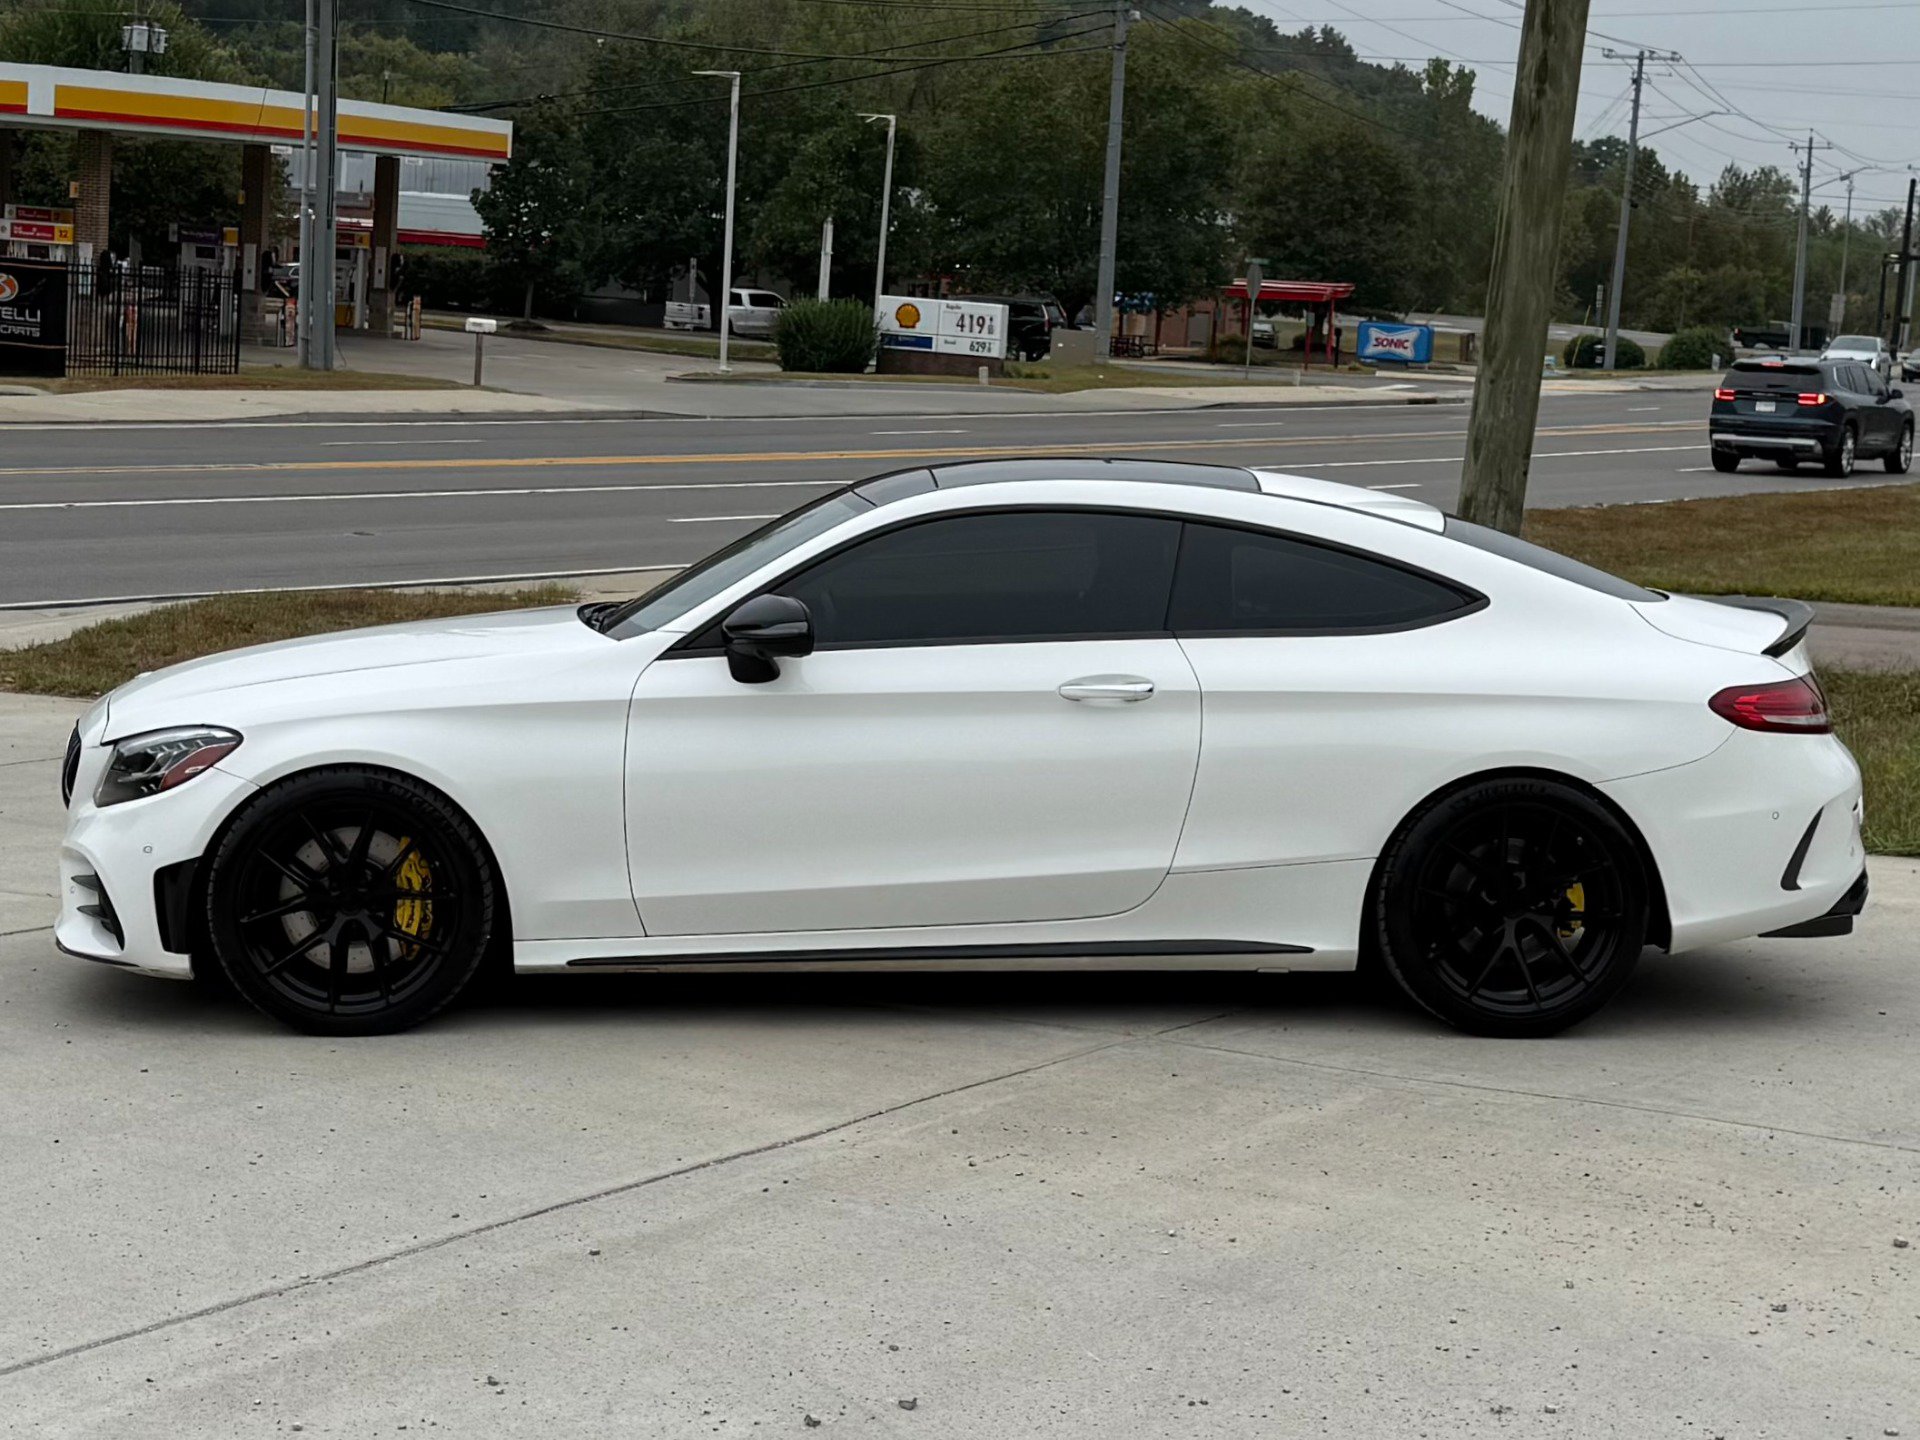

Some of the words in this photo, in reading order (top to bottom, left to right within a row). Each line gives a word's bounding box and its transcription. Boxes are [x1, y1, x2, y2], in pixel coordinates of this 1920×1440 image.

[0, 306, 41, 322] ELLI
[0, 324, 41, 337] CARTS
[956, 314, 986, 334] 419
[969, 341, 987, 352] 629
[1373, 338, 1409, 349] SONIC
